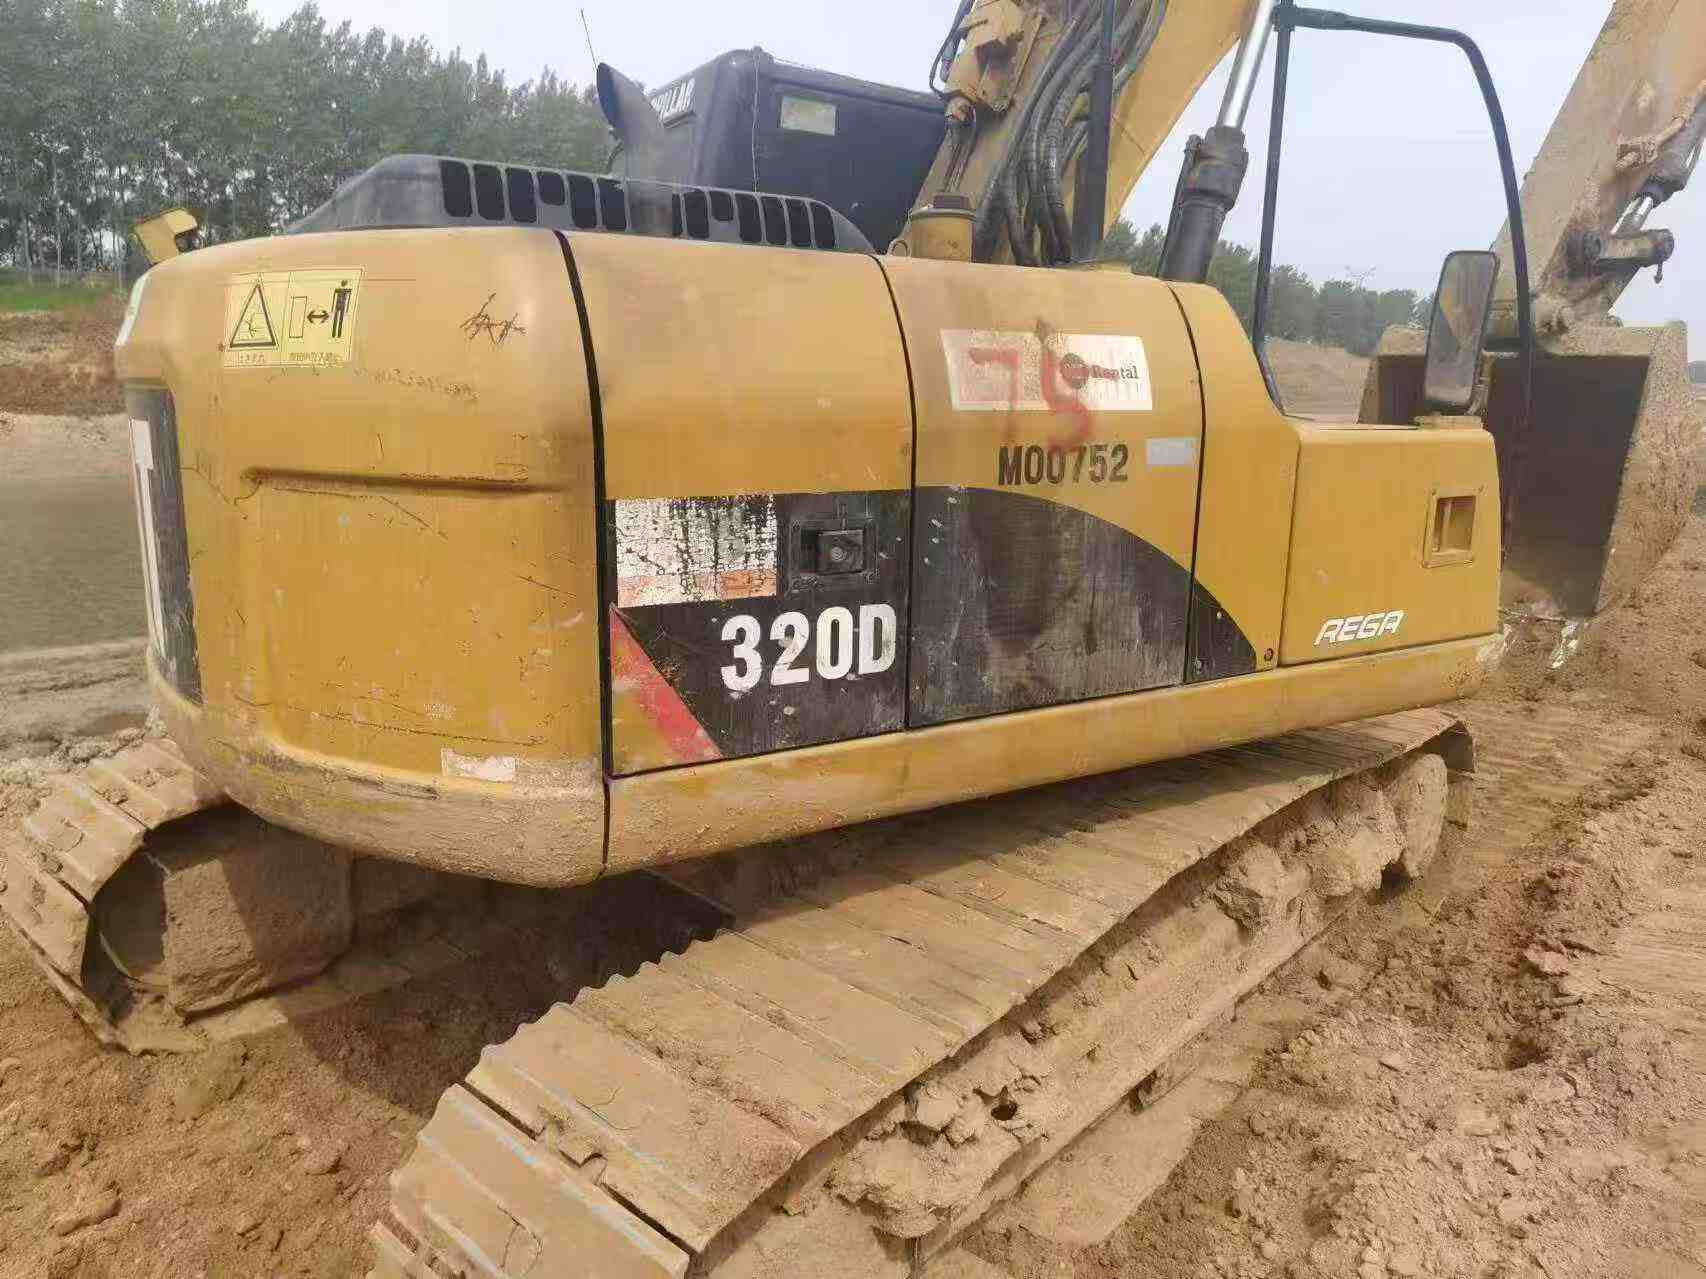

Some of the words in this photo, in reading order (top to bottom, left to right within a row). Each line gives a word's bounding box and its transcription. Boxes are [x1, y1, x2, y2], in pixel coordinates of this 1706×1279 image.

[998, 444, 1129, 486] M00752
[720, 603, 897, 692] 320D
[1312, 609, 1405, 647] REGA
